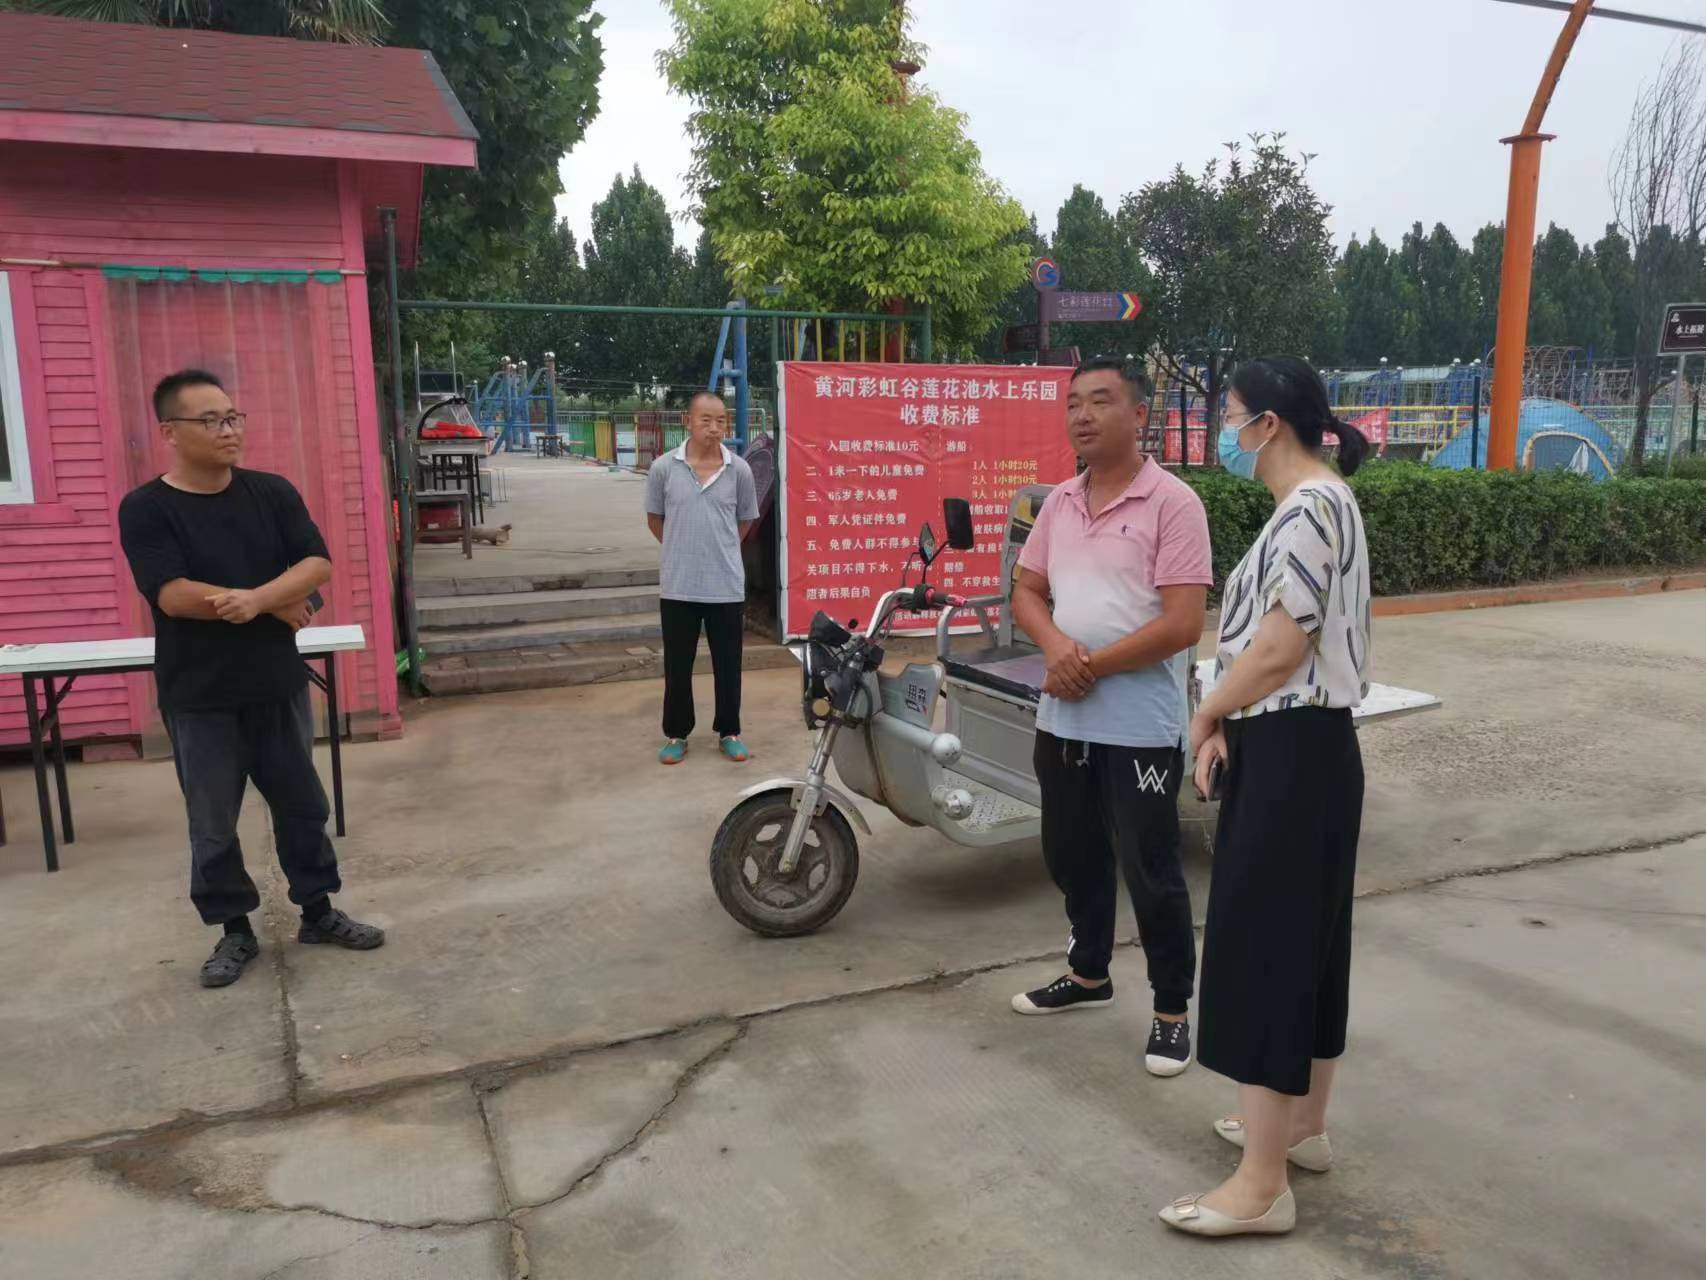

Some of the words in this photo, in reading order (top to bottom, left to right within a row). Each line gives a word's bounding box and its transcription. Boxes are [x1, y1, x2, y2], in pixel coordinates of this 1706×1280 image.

[814, 375, 1058, 401] 黄河彩虹谷莲花池水上乐园
[900, 403, 981, 426] 收费标准
